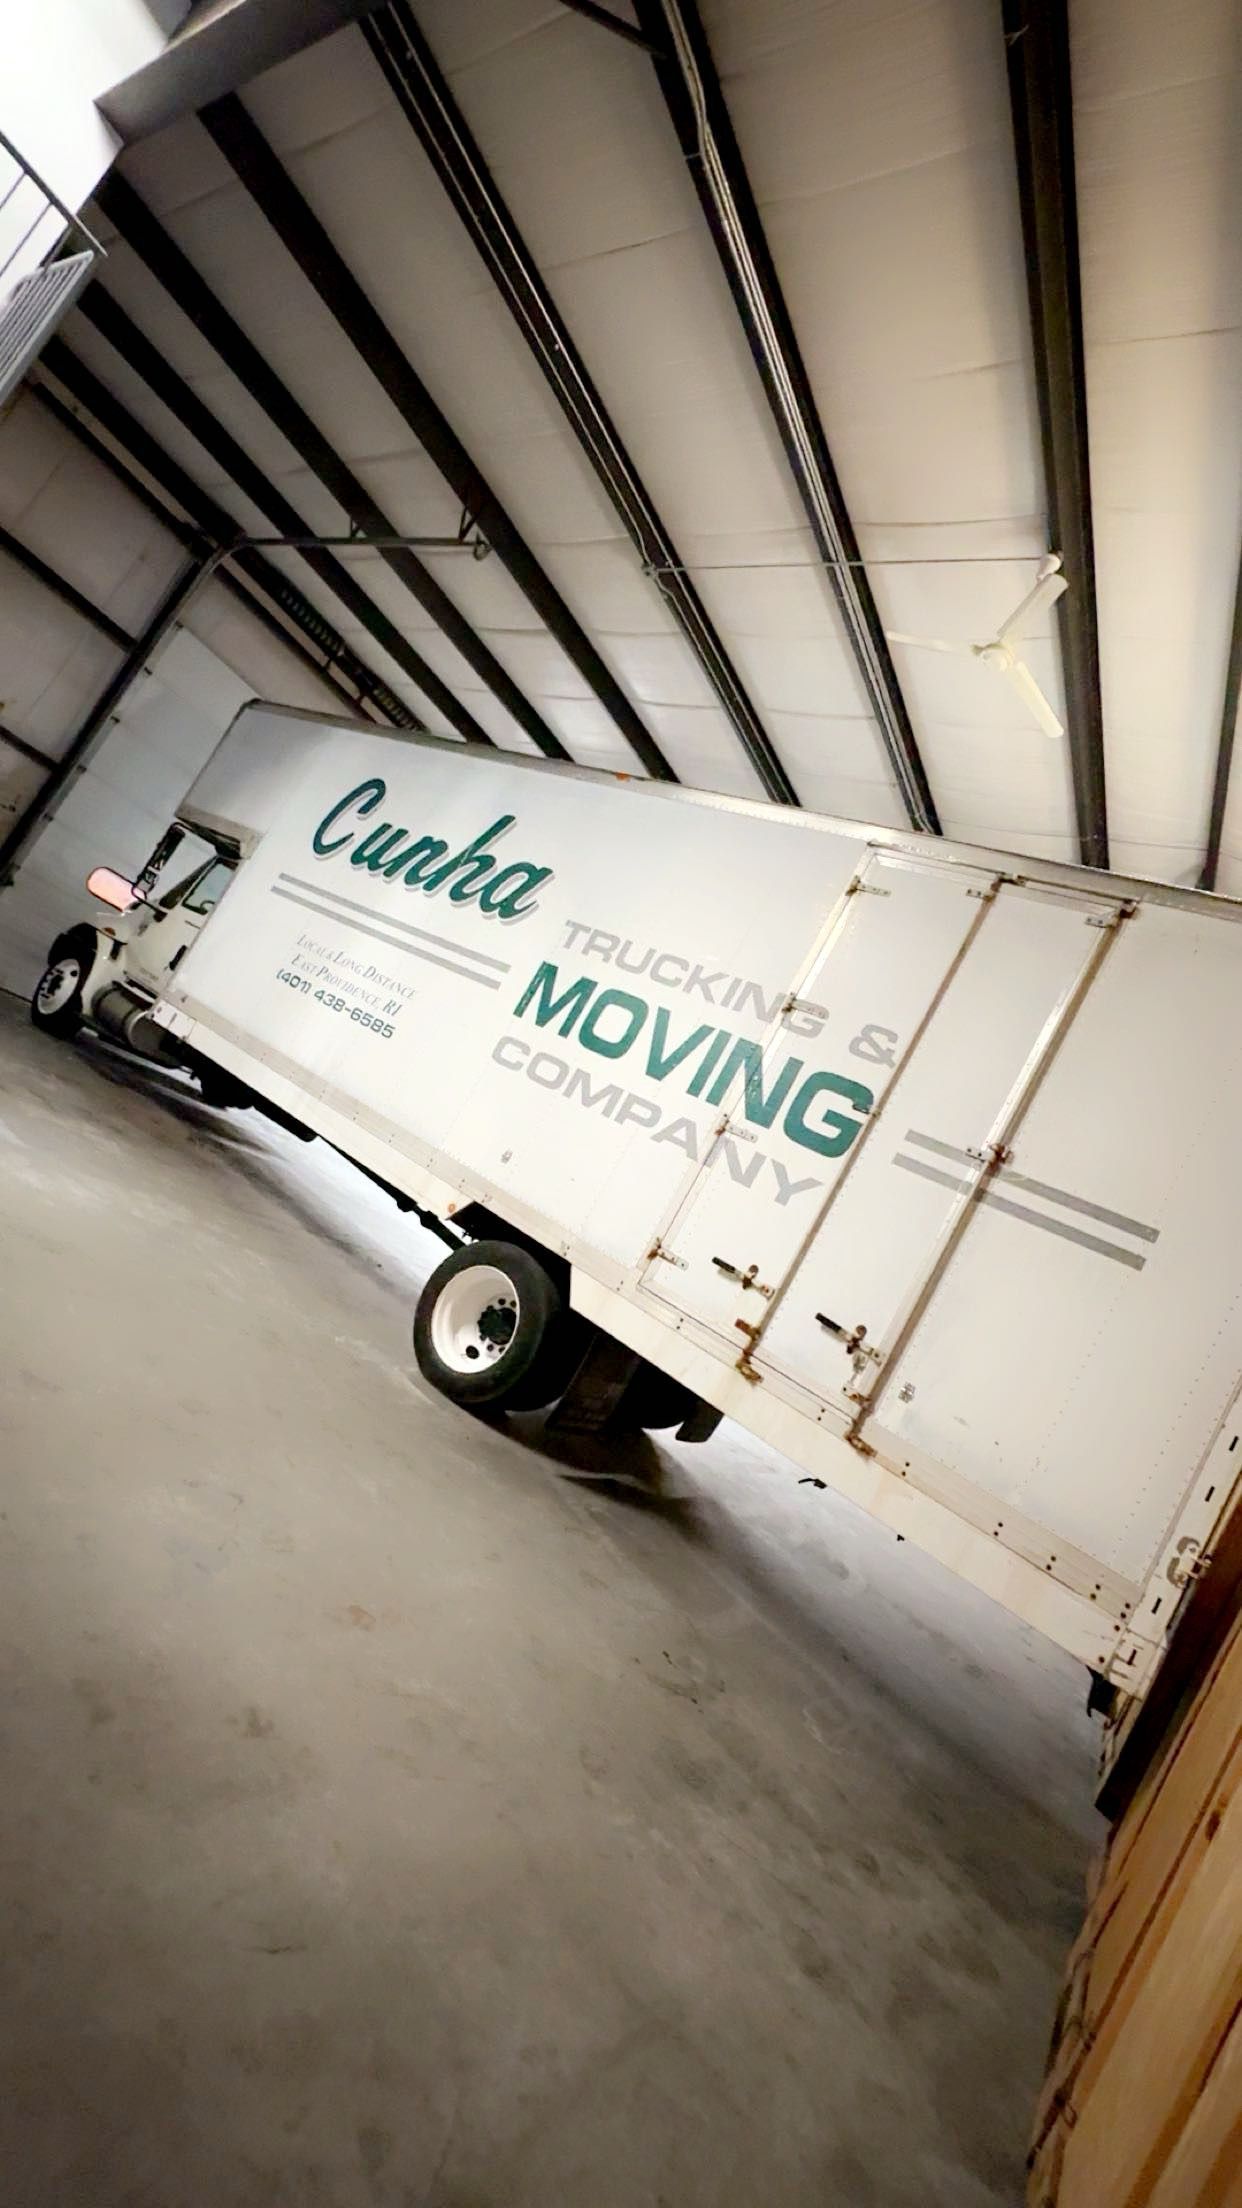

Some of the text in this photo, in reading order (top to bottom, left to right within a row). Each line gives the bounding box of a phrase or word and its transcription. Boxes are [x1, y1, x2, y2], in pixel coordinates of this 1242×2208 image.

[313, 778, 556, 925] Cunha
[276, 968, 396, 1039] (401) 438-6585
[513, 960, 875, 1158] MOVING
[562, 919, 899, 1069] TRUCKING &
[491, 1034, 824, 1207] COMPANY
